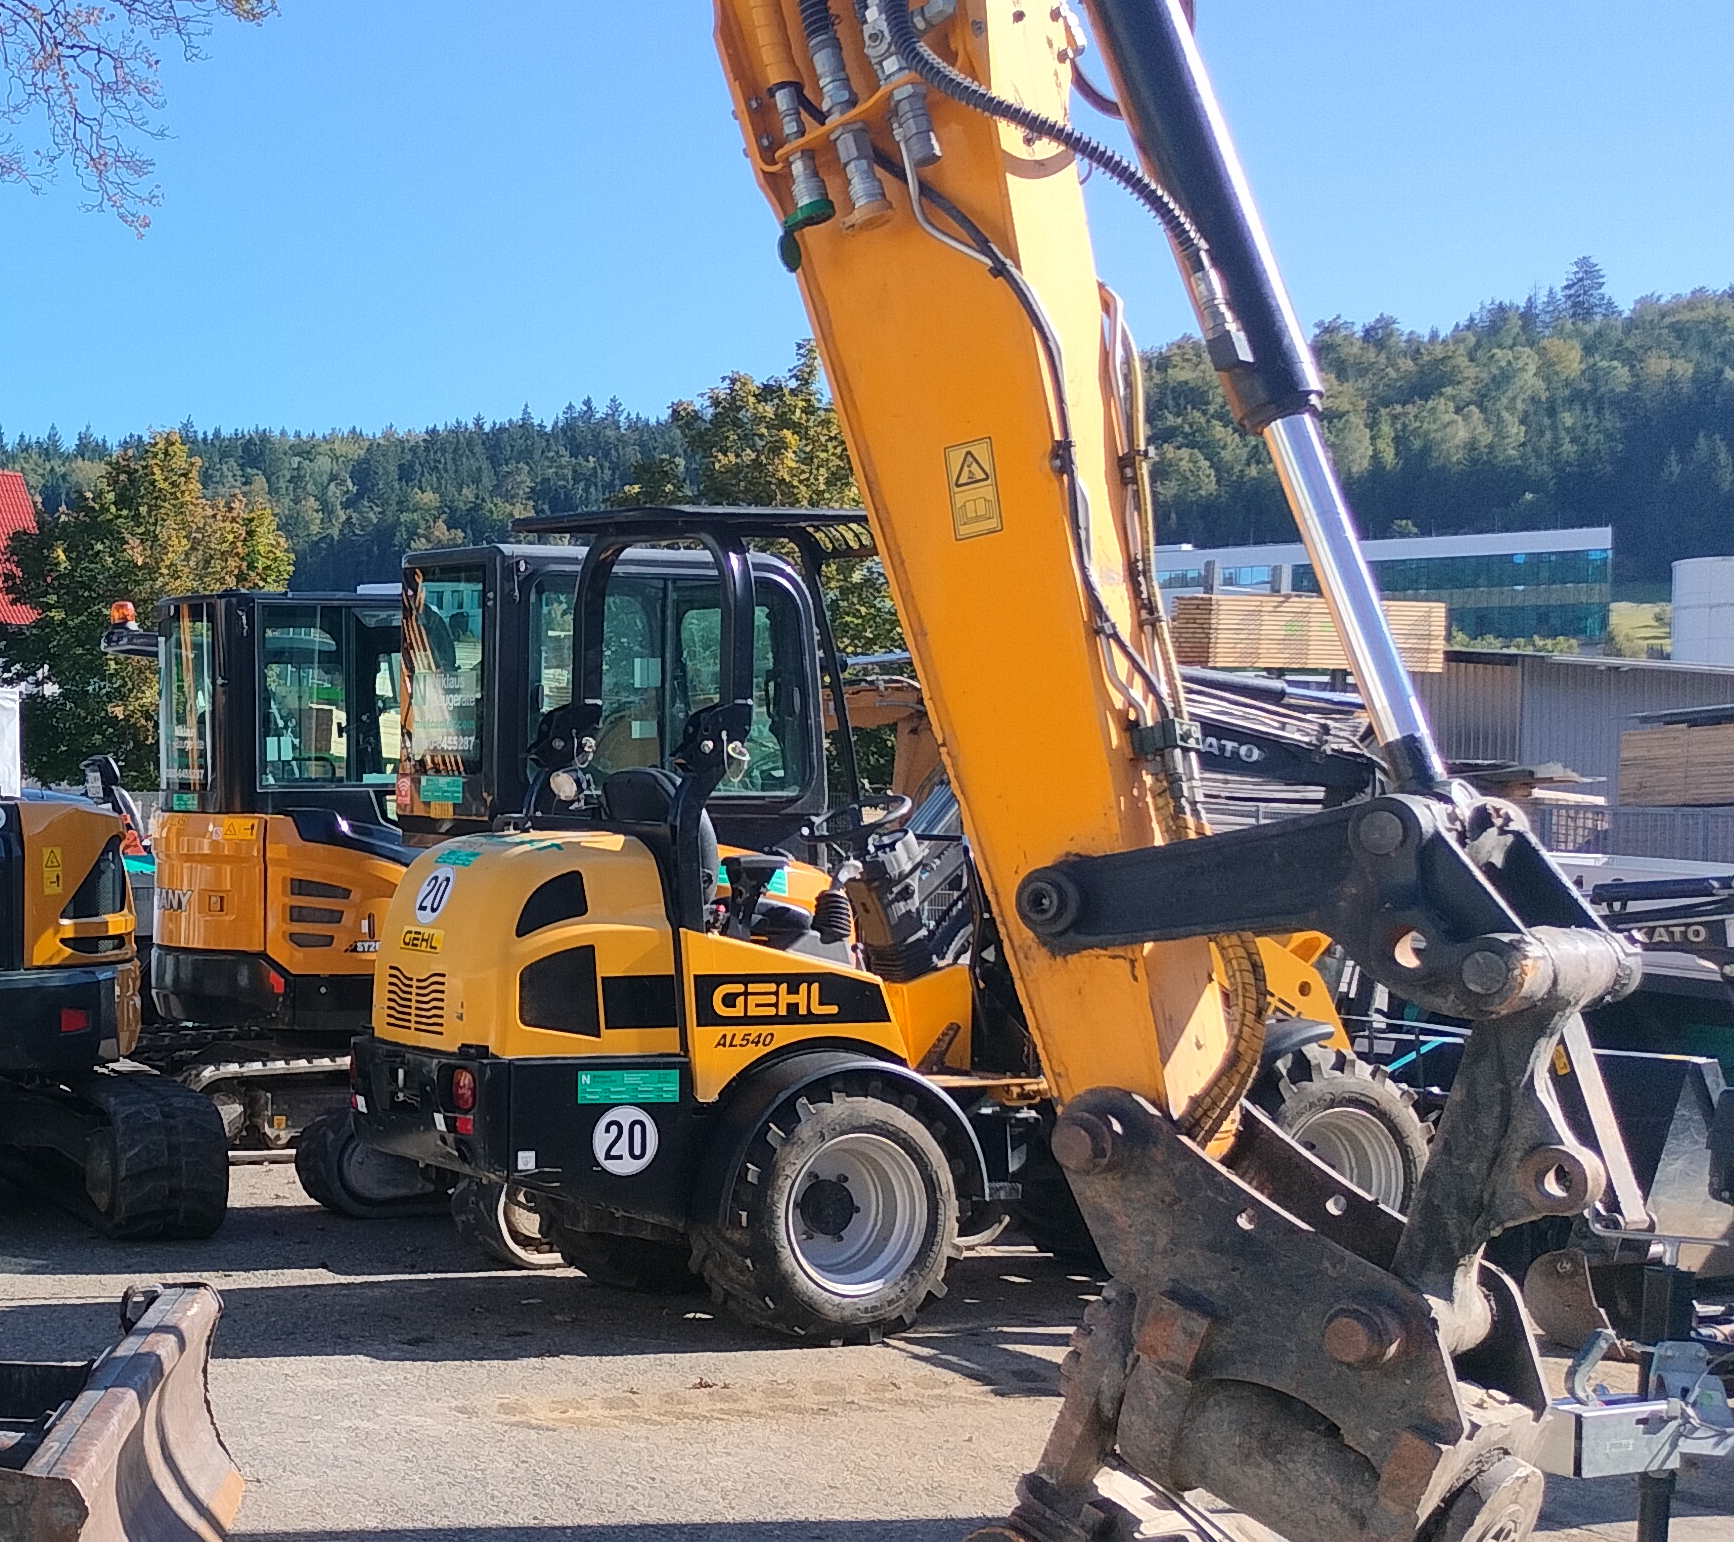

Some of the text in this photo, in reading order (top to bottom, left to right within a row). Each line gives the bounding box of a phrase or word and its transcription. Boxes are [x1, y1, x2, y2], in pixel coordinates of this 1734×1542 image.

[1200, 736, 1260, 762] ATO
[417, 875, 451, 914] 20
[402, 929, 438, 950] GEHL
[712, 982, 840, 1017] GEHL
[714, 1032, 775, 1049] AL540
[603, 1119, 648, 1161] 20
